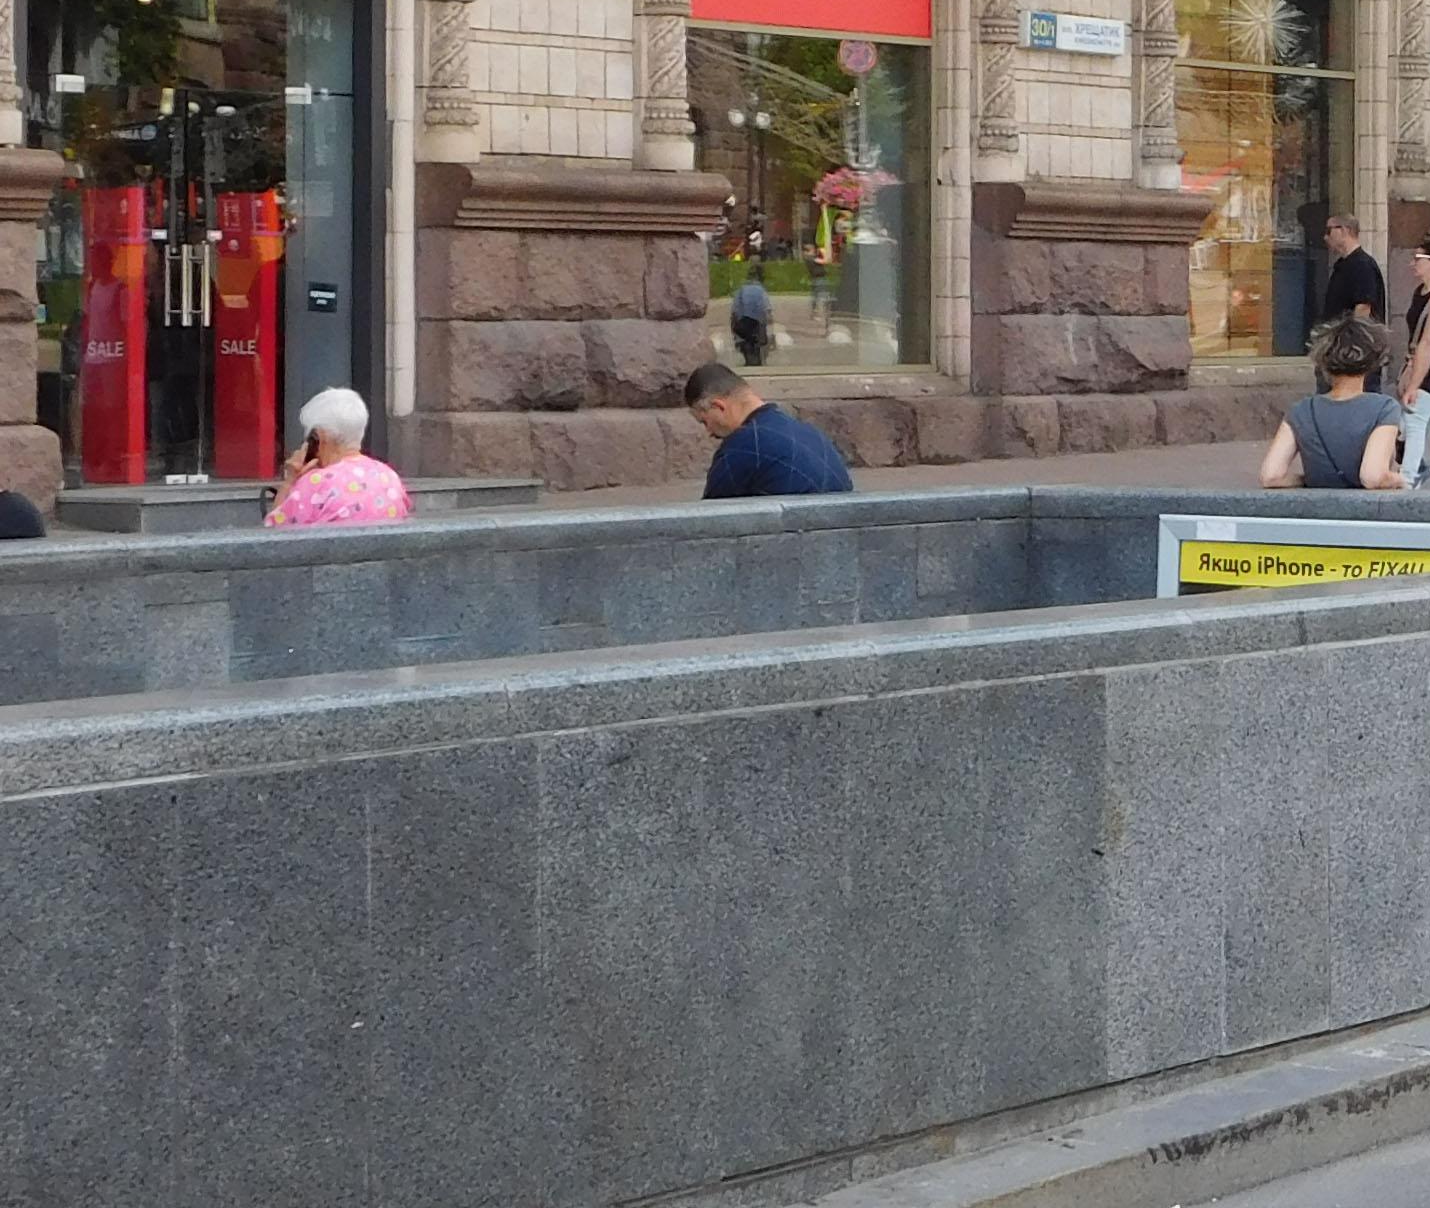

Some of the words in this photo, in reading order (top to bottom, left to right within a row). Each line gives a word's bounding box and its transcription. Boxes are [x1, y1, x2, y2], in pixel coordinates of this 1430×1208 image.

[87, 339, 124, 357] SALE
[221, 339, 257, 355] SALE
[1199, 553, 1252, 576] Якщо
[1258, 555, 1324, 577] iPhone
[1342, 564, 1363, 578] то
